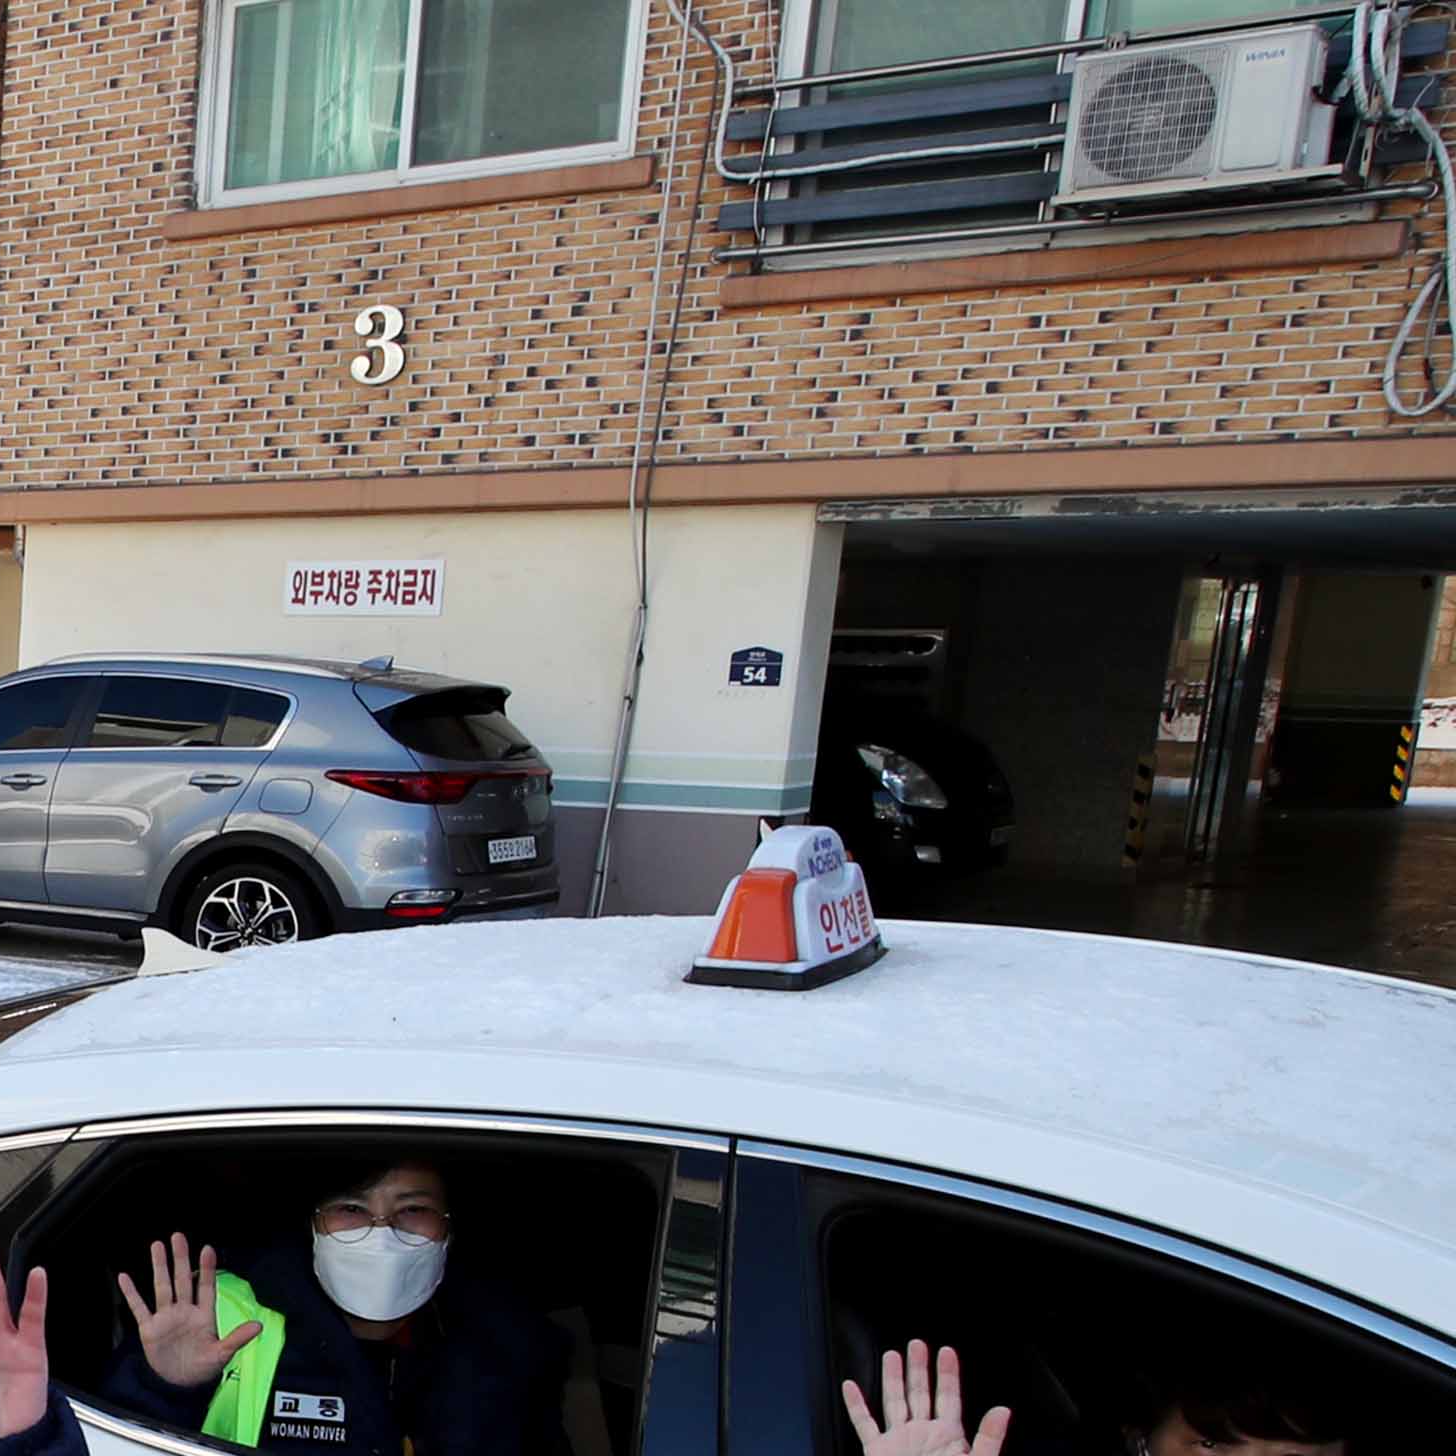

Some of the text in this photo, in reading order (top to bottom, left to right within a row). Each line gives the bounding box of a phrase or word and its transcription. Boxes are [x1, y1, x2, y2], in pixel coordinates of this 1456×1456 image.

[350, 304, 405, 386] 3
[291, 569, 437, 606] 외부차량 주차금지
[742, 666, 767, 683] 54
[820, 890, 872, 954] 인천콜
[270, 1422, 346, 1442] WOMAN DRIVER
